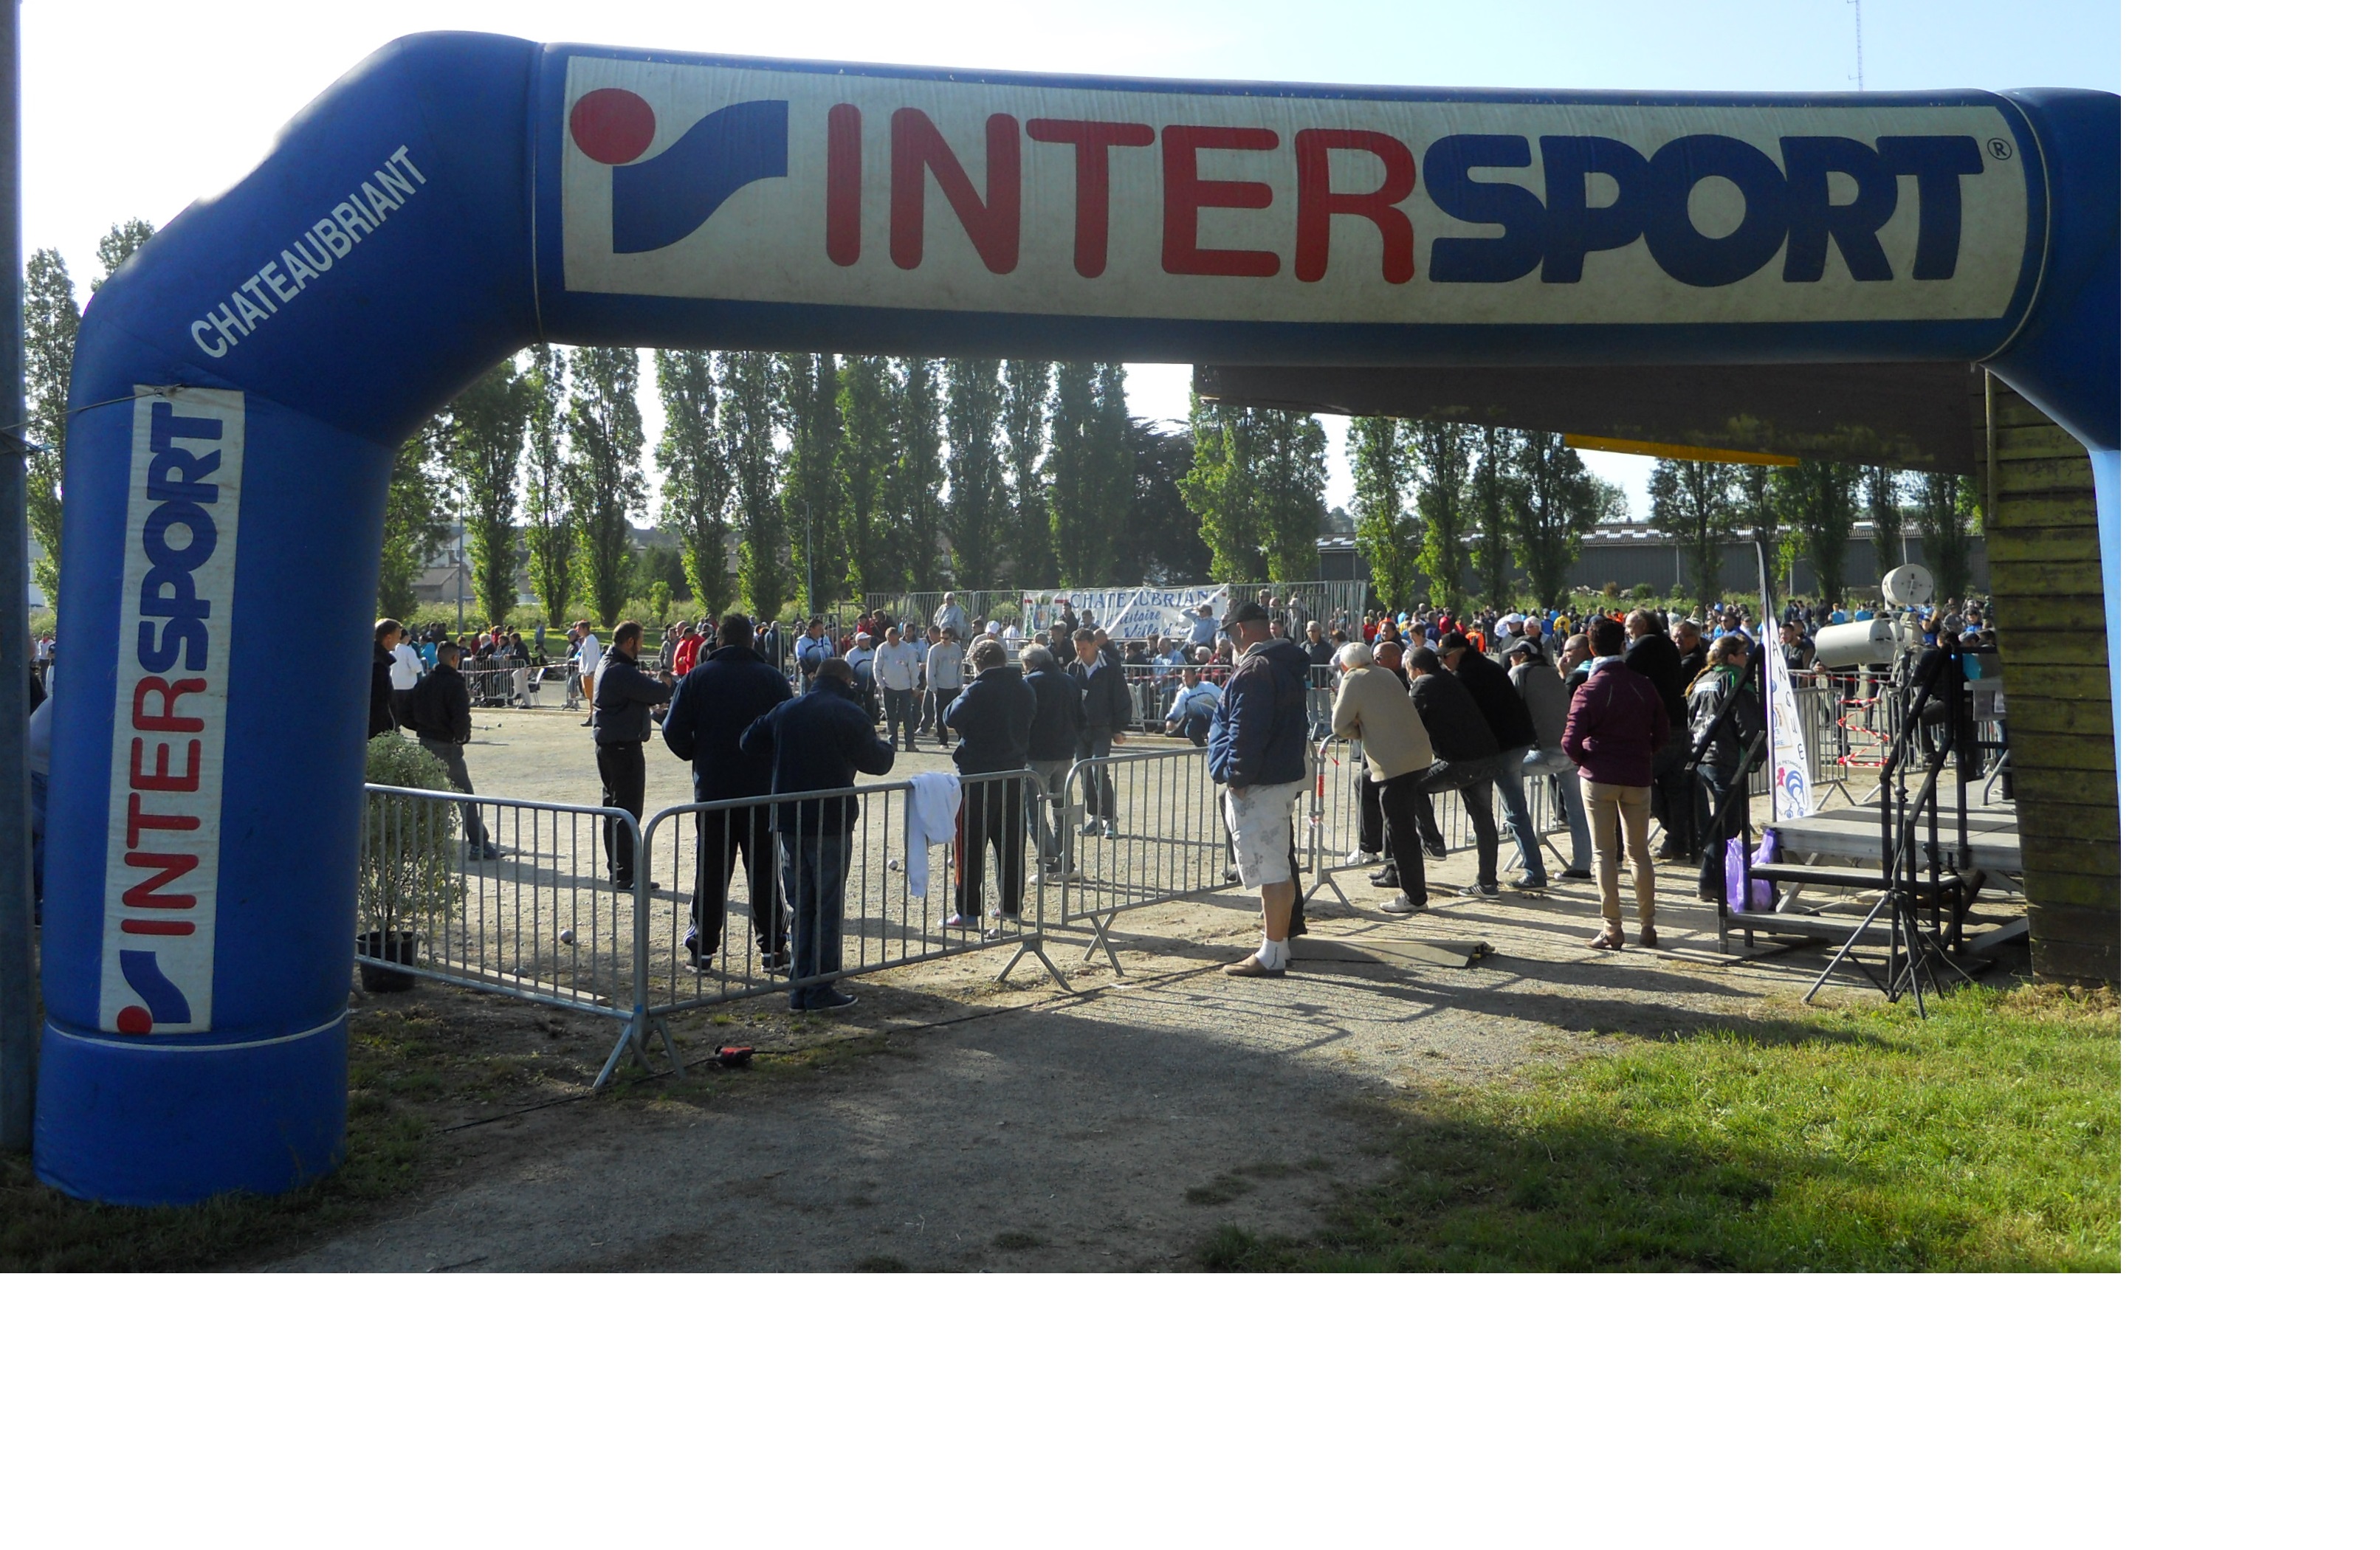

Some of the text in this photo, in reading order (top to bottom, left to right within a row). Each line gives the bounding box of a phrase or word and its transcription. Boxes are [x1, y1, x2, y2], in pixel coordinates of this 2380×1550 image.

[190, 144, 427, 359] CHATEAUBRIANT
[826, 102, 1984, 288] INTERSPORT
[120, 402, 224, 937] INTERSPORT
